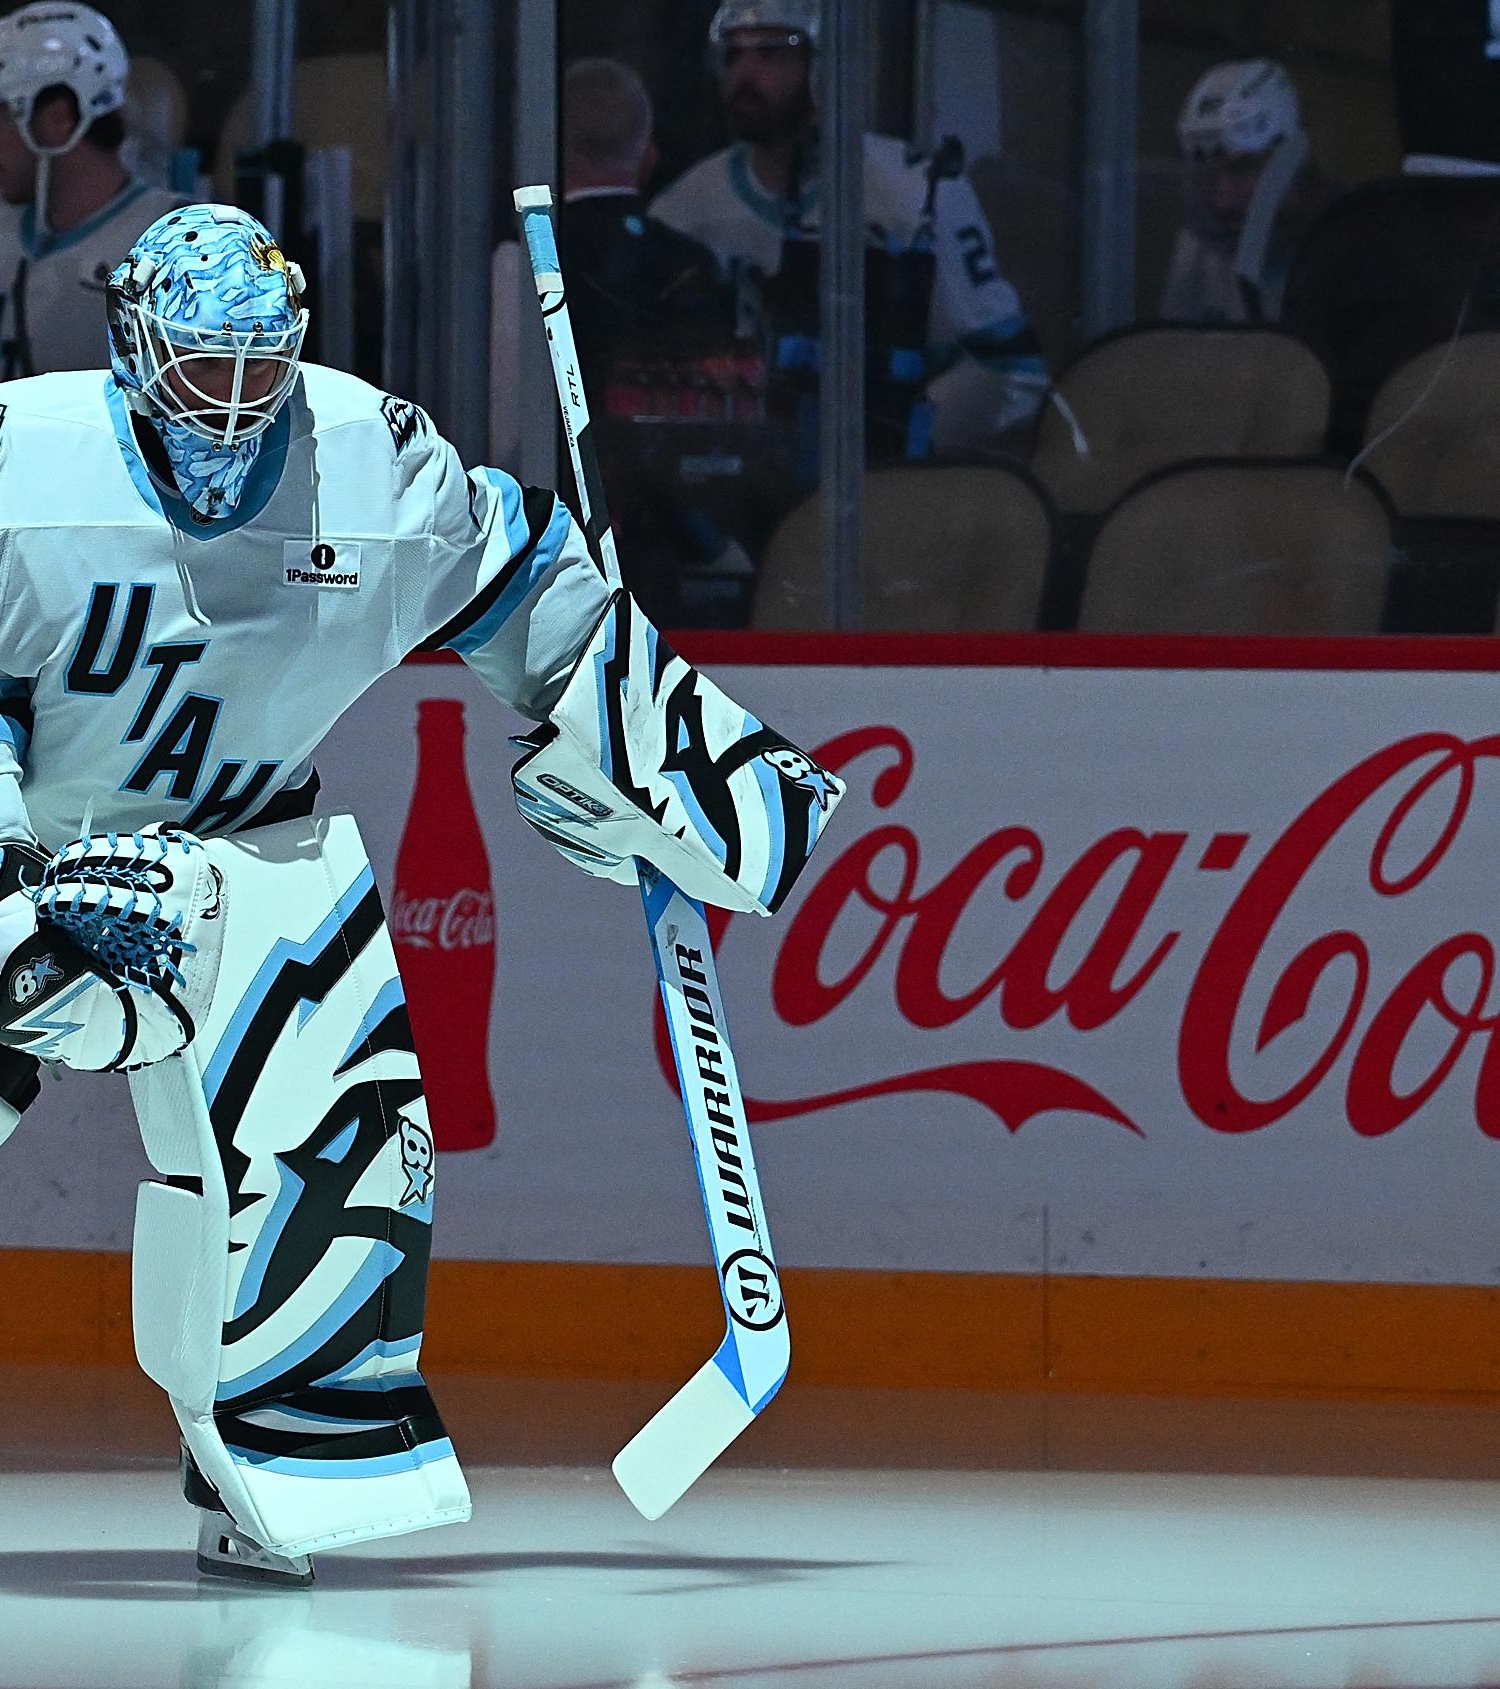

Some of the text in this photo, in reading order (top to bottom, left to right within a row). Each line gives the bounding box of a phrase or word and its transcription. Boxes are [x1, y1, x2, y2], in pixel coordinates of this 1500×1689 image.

[563, 406, 575, 447] VEJMELKA
[285, 568, 358, 585] 1Password
[63, 582, 284, 836] UTAH
[654, 726, 1500, 1139] Coca-Co
[674, 943, 755, 1232] WARRIOR
